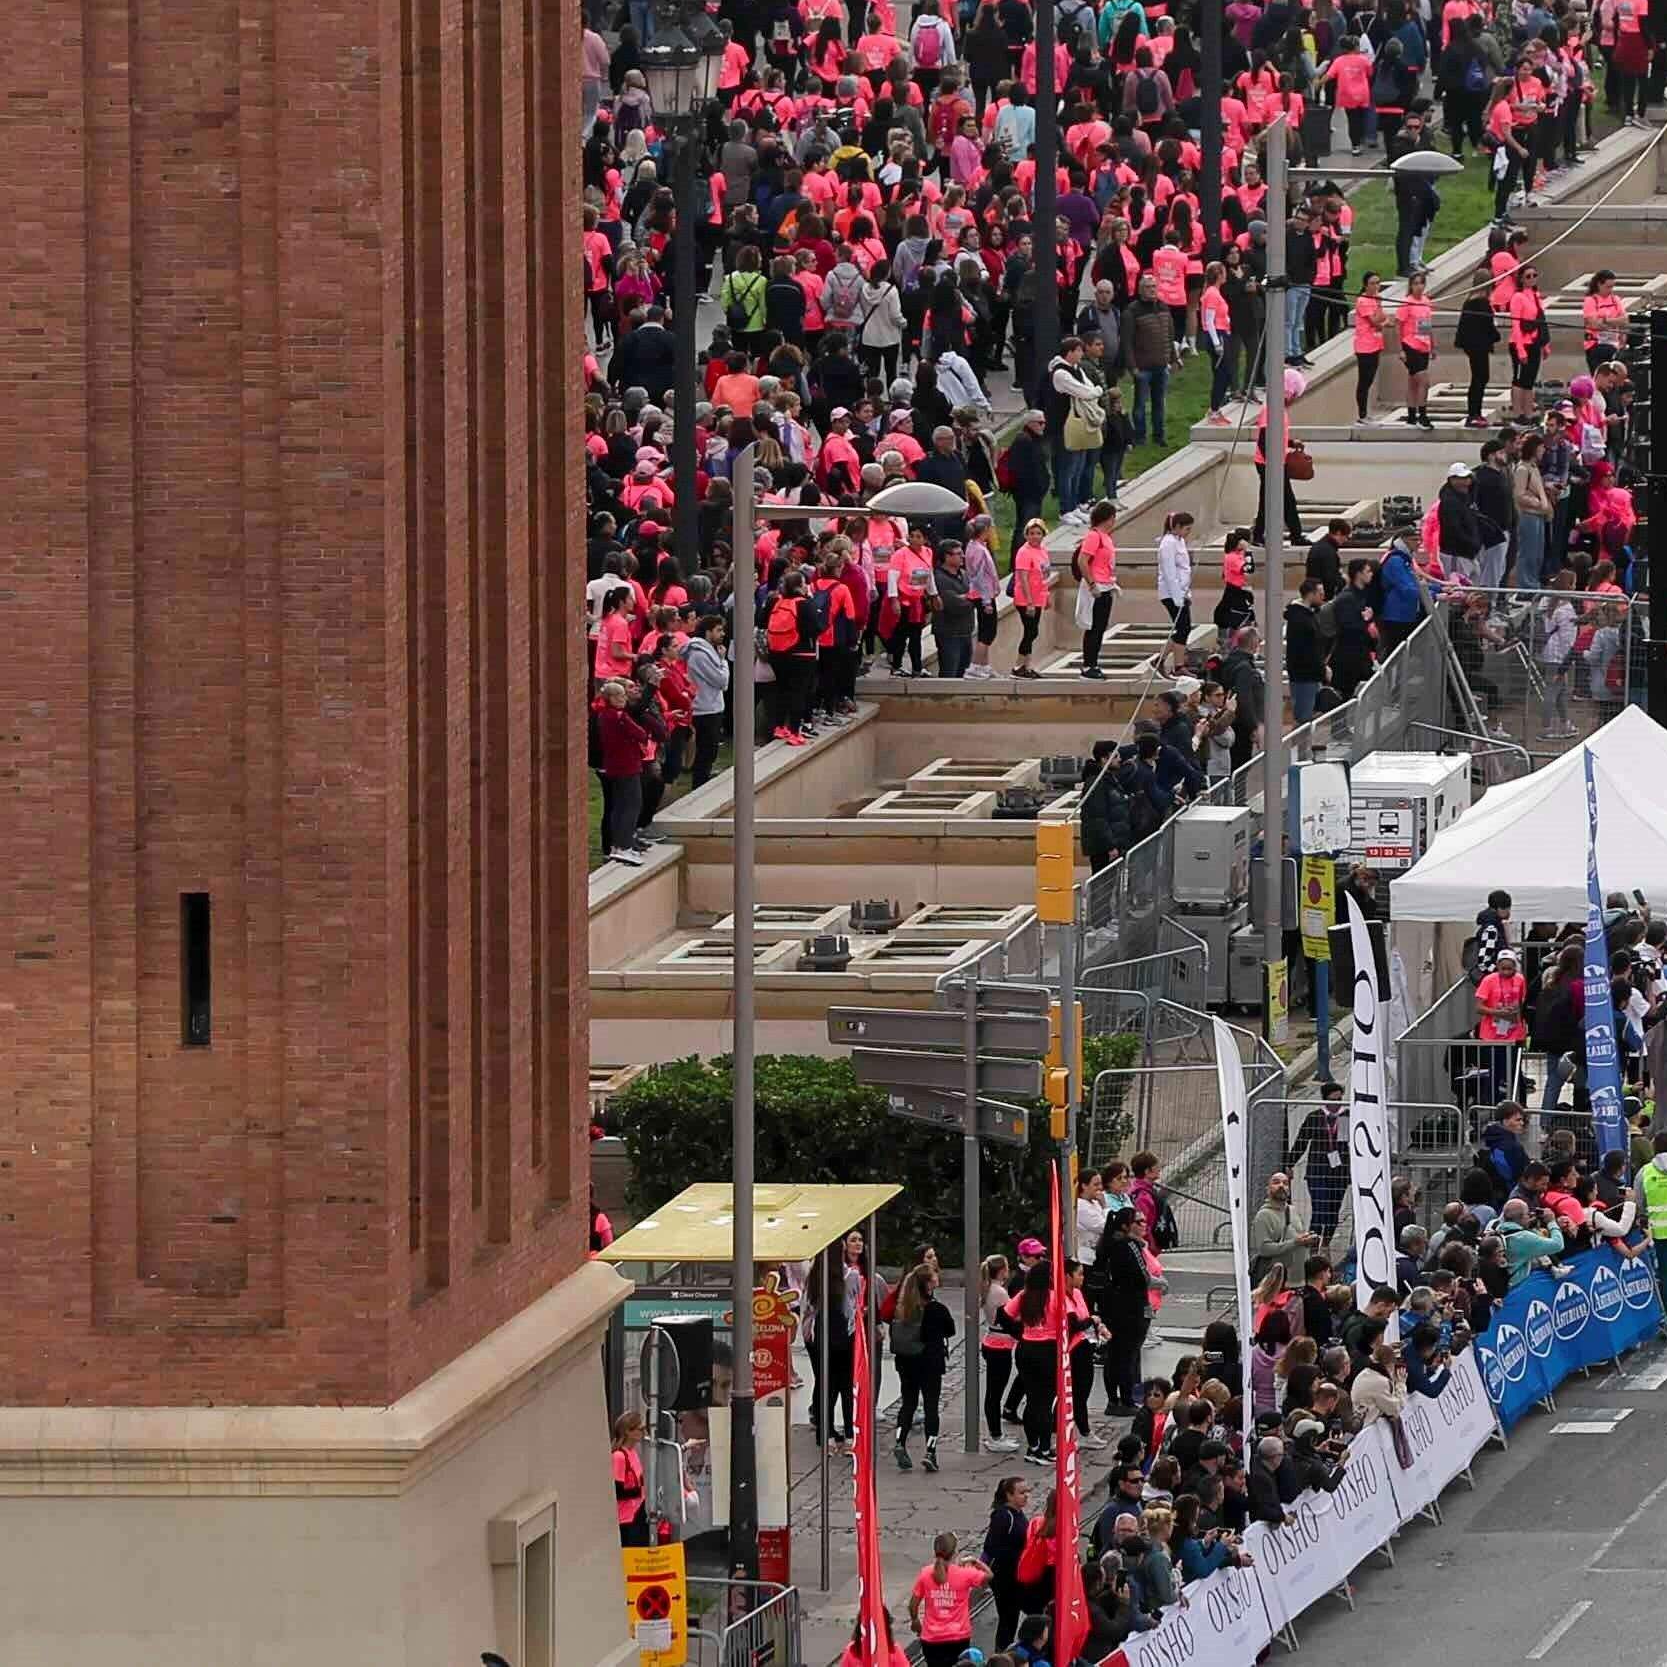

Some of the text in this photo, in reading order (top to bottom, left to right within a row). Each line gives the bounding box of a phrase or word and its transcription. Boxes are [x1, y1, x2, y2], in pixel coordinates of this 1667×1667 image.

[1556, 1300, 1588, 1330] ASTURIANA
[1405, 1405, 1434, 1457] SHO
[1262, 1501, 1320, 1575] OYSHO
